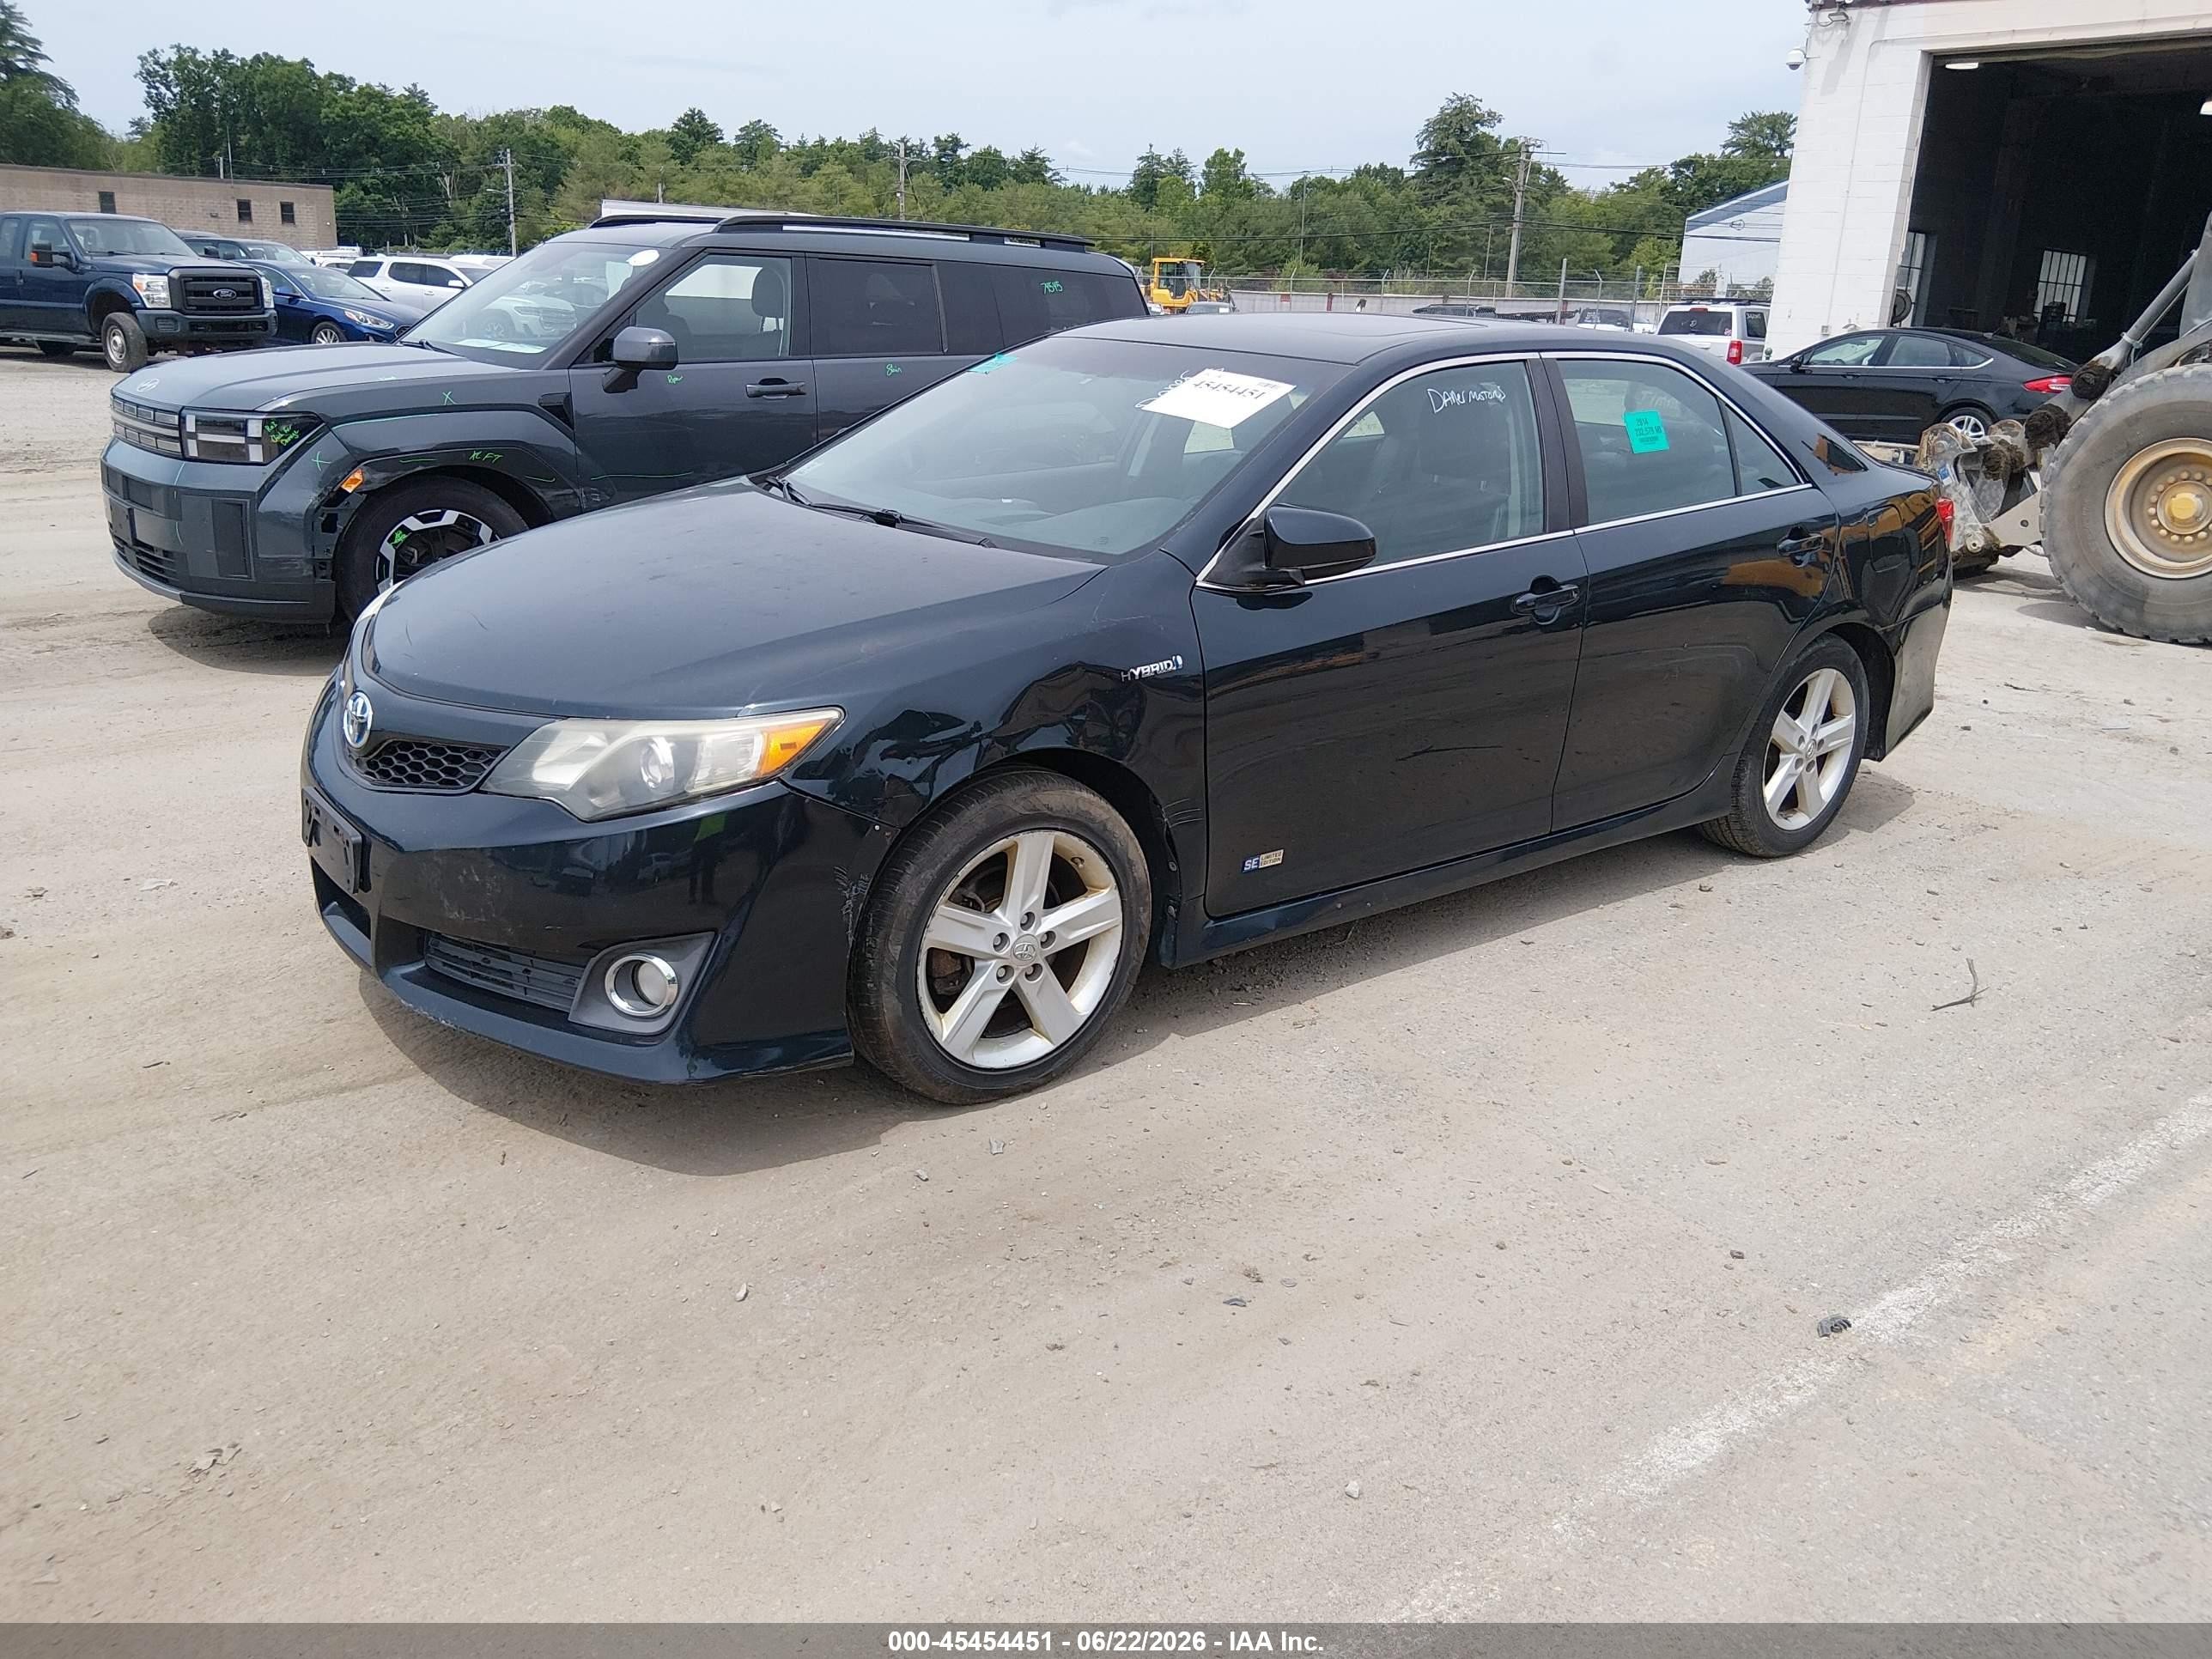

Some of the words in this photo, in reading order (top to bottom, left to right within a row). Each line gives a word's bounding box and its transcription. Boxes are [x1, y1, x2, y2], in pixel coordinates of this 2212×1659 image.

[1120, 659, 1176, 682] HYBRID
[1261, 851, 1282, 860] LIMITED
[1243, 857, 1260, 871] SE
[1260, 857, 1281, 866] EDITION
